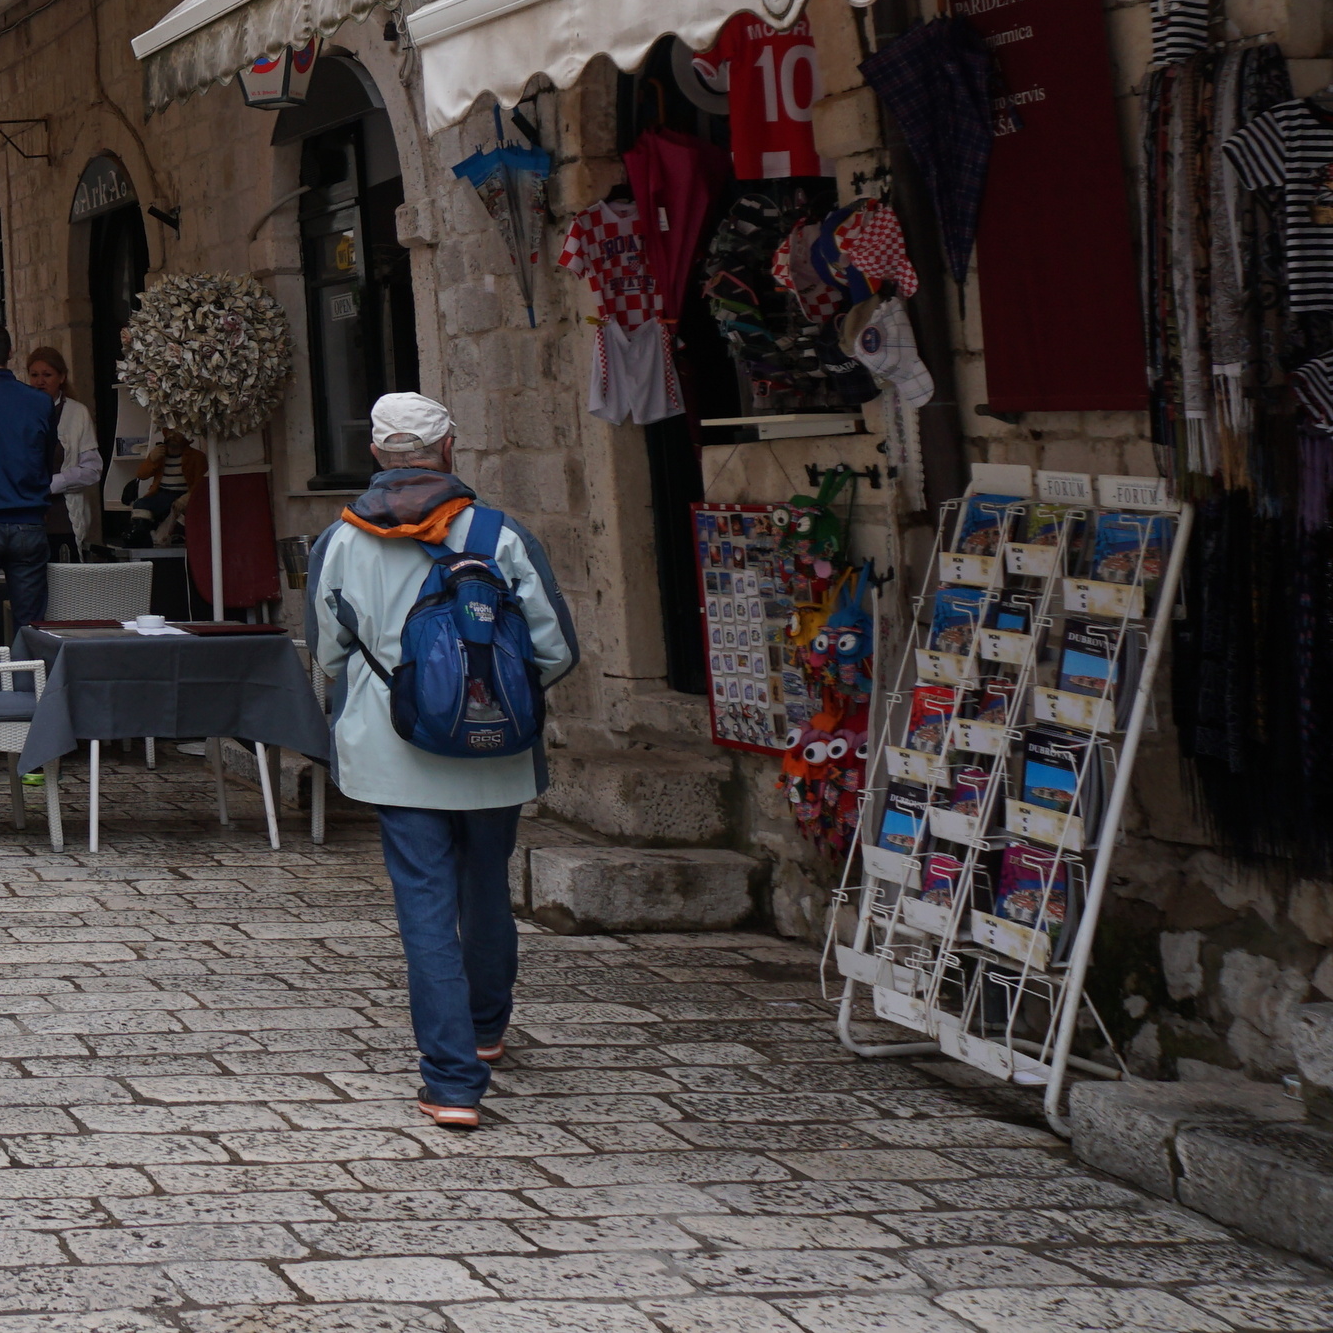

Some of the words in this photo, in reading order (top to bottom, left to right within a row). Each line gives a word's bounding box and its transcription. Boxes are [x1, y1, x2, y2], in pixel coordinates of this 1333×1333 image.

[984, 24, 1034, 50] njarnica
[754, 45, 822, 122] 10
[1008, 84, 1046, 105] servis
[334, 298, 352, 315] OPEN
